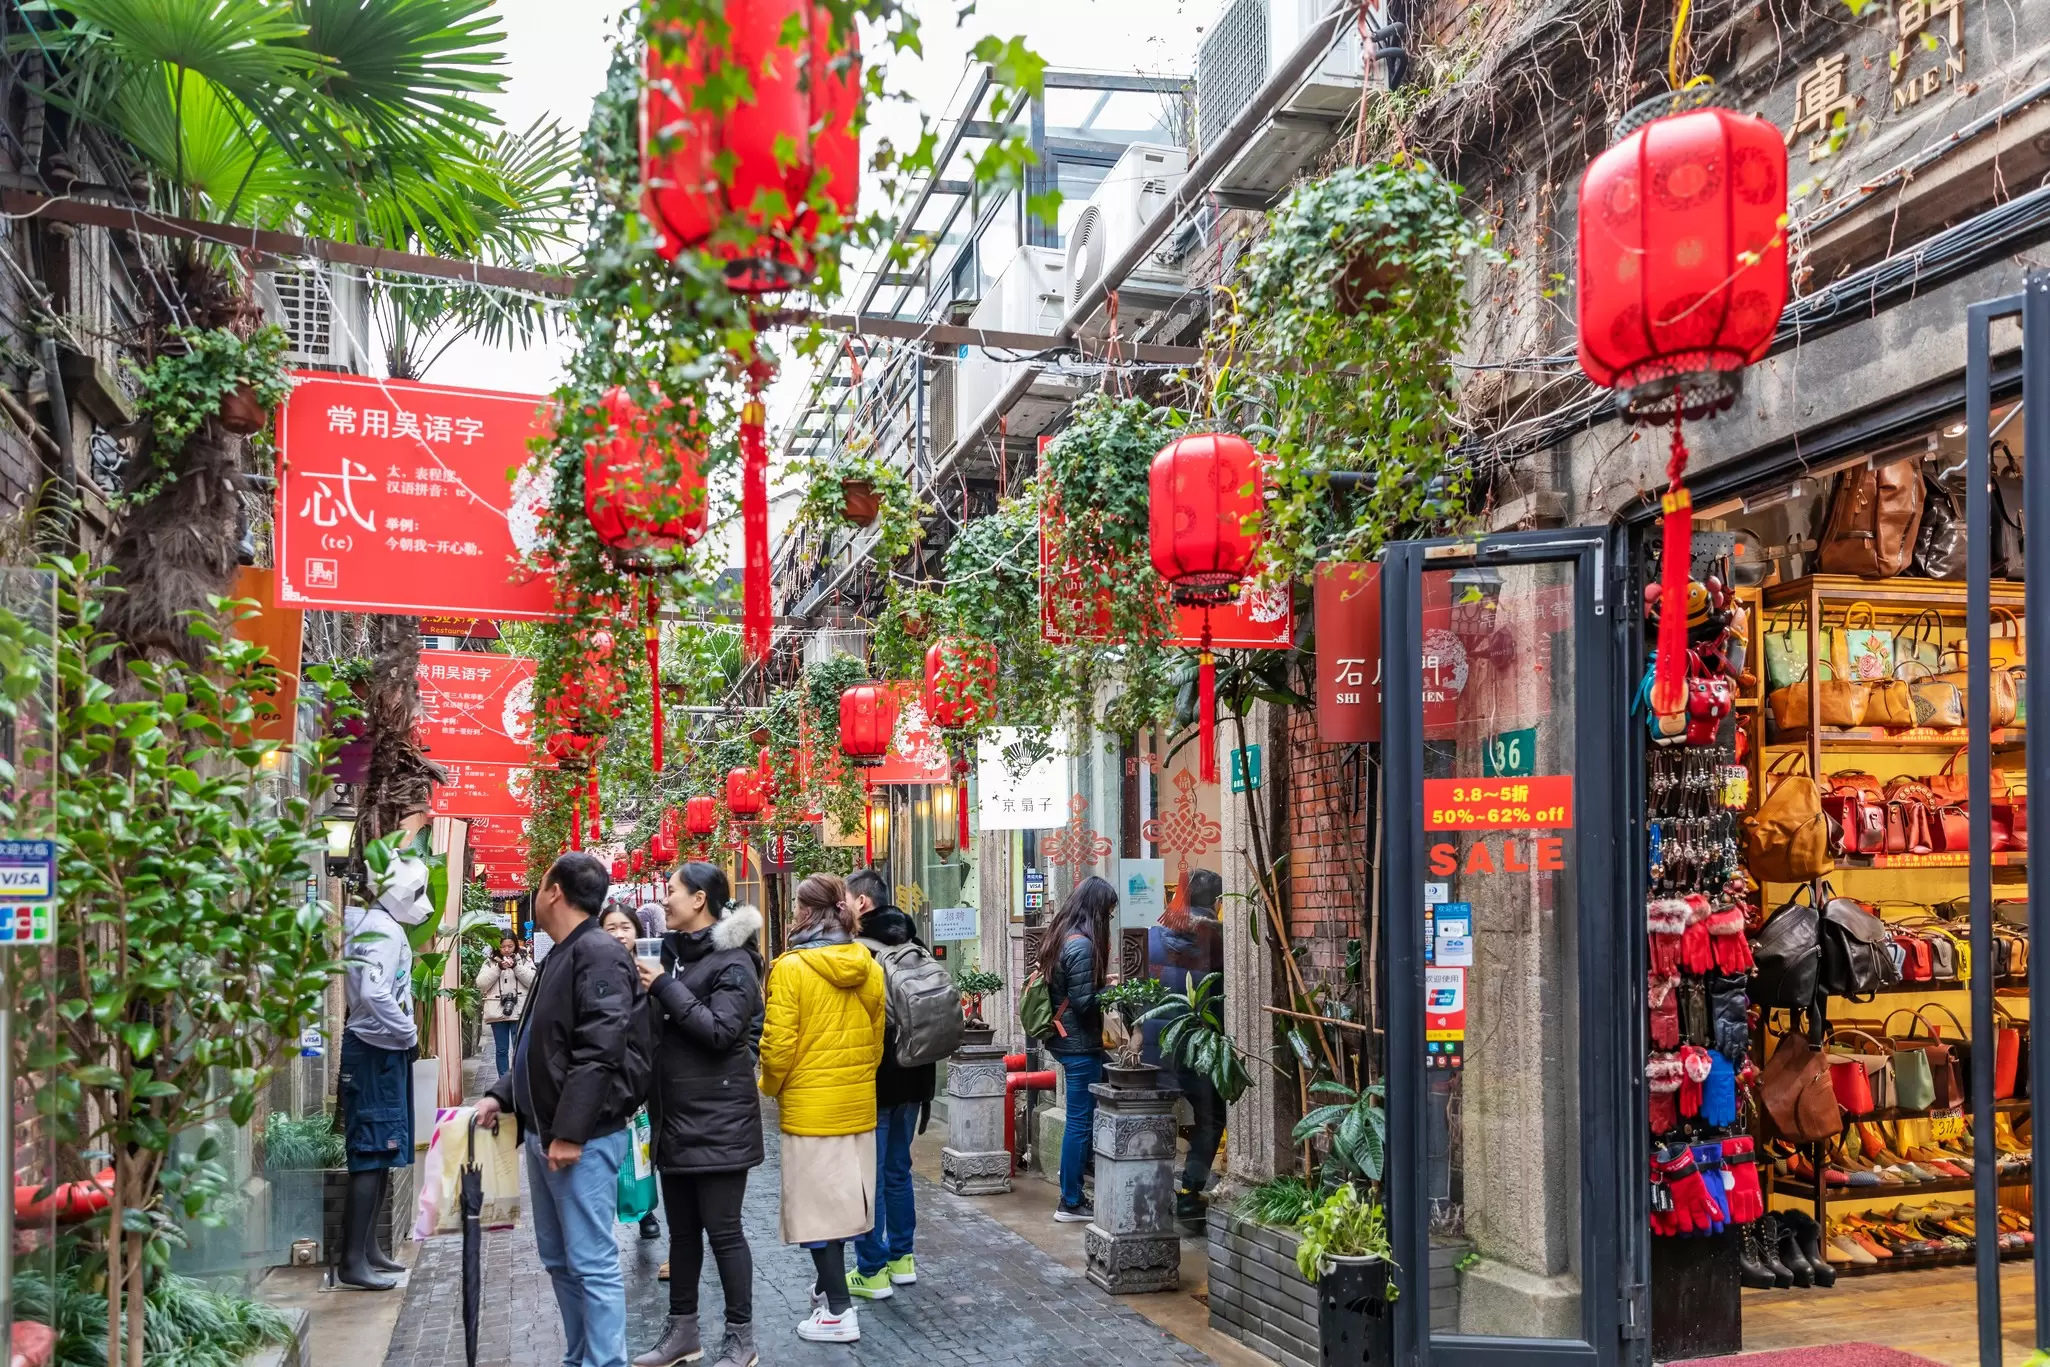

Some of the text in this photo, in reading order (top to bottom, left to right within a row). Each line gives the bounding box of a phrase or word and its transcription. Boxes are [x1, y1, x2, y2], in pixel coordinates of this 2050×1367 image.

[1893, 49, 1967, 114] MEN
[327, 404, 485, 446] 常用吴语字
[416, 663, 492, 682] 常用吴语字
[1336, 692, 1360, 704] SHI
[1495, 738, 1520, 771] 36
[1002, 797, 1053, 812] 京扇子
[1535, 806, 1565, 822] off
[1429, 837, 1566, 877] SALE
[1, 872, 40, 885] VISA
[303, 1035, 320, 1043] VISA
